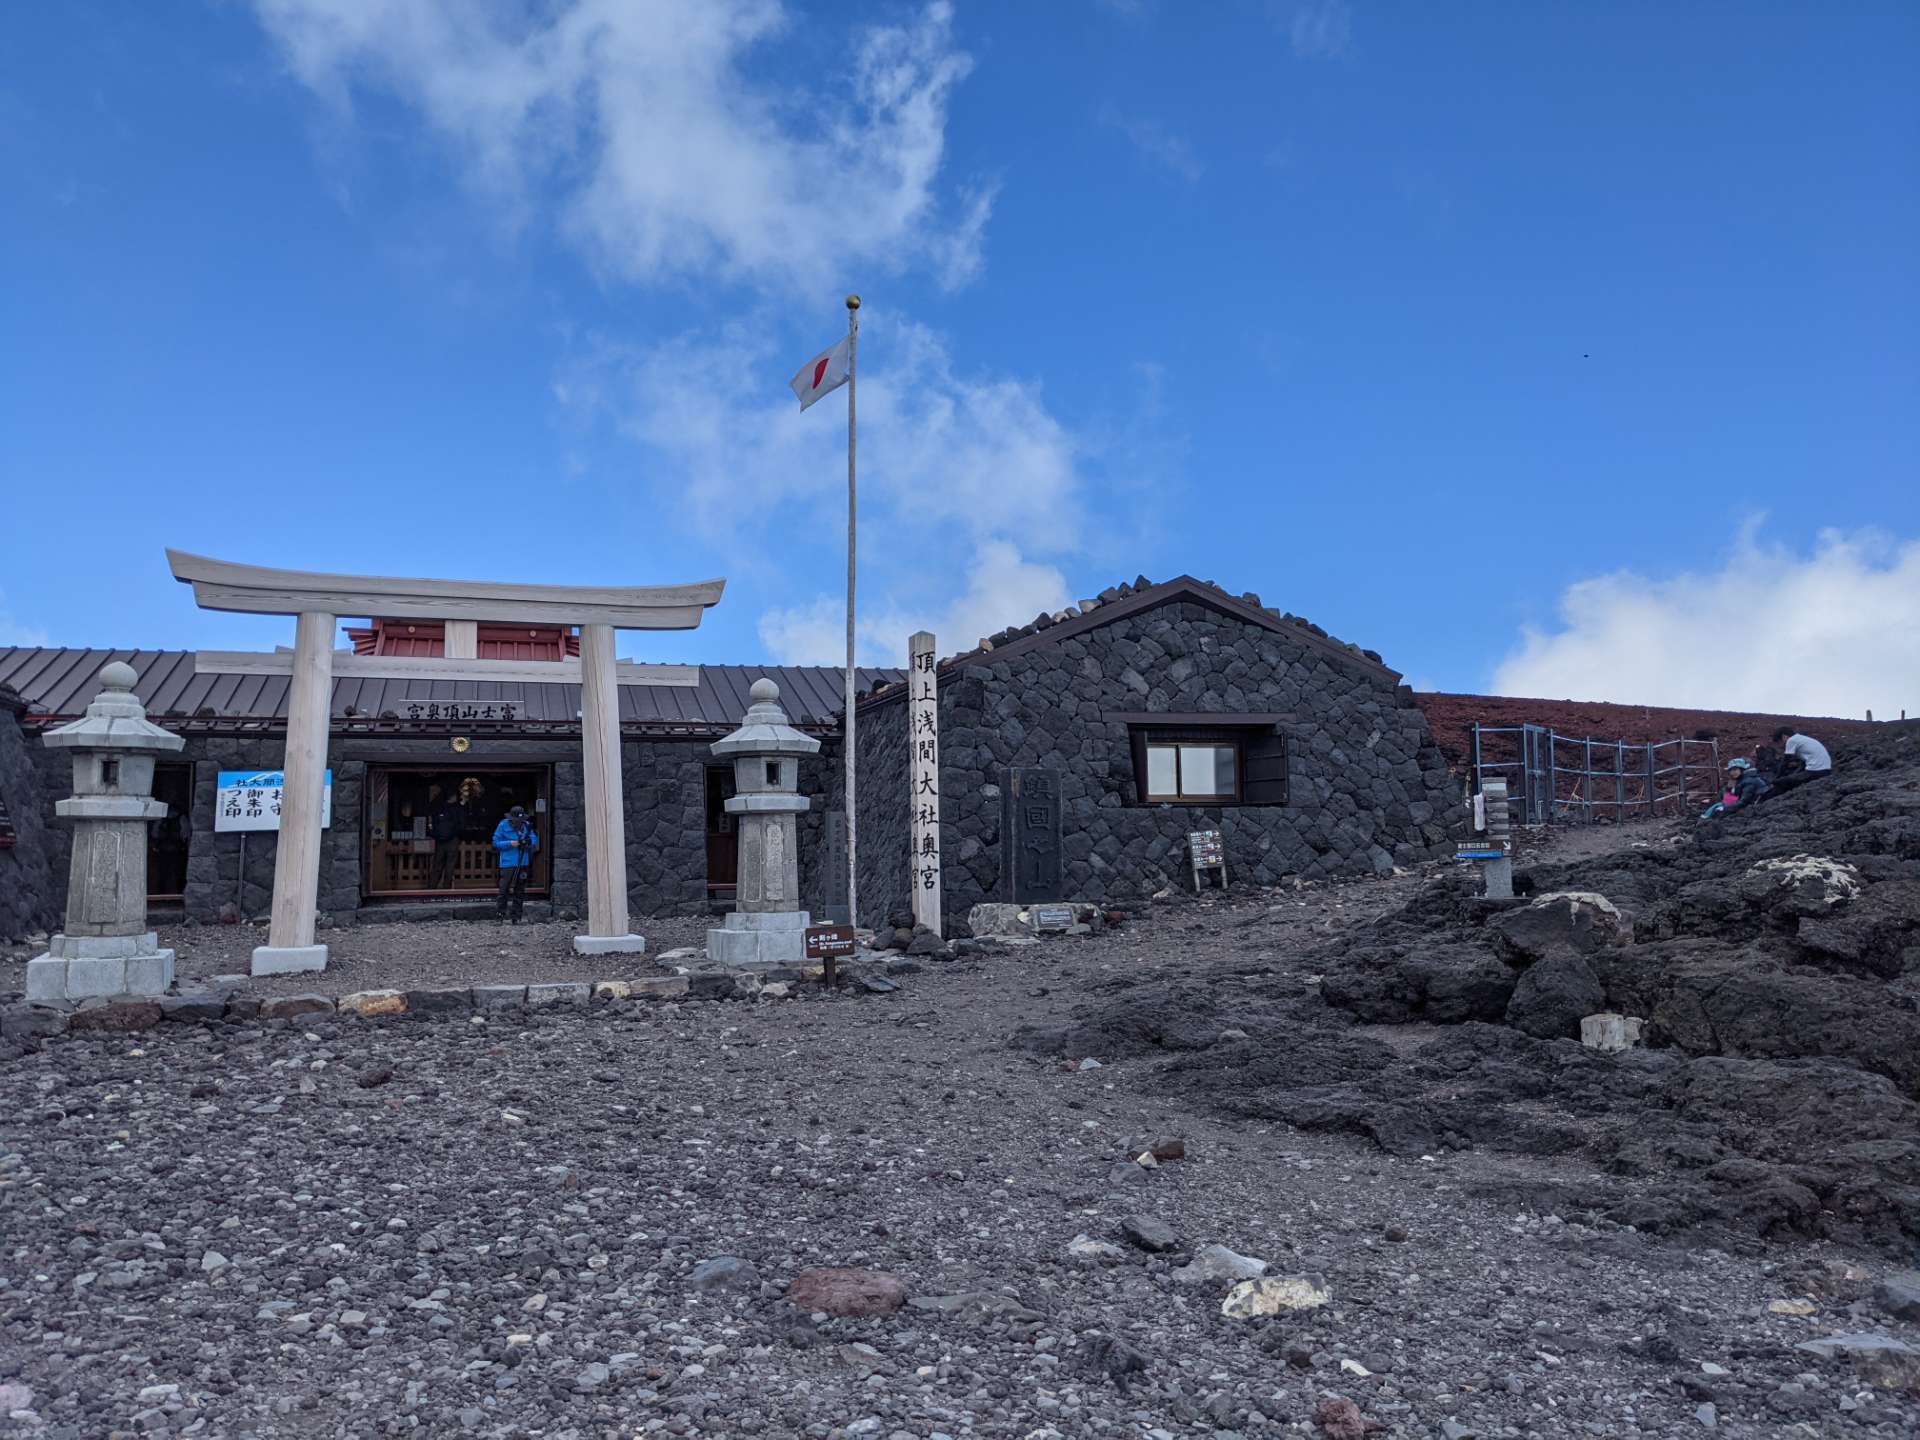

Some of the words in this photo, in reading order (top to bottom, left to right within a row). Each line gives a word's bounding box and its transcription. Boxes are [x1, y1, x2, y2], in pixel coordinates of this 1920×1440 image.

[917, 651, 939, 890] 頂上浅間大社奥宮
[225, 788, 242, 818] つえ印
[246, 788, 263, 818] 御朱印
